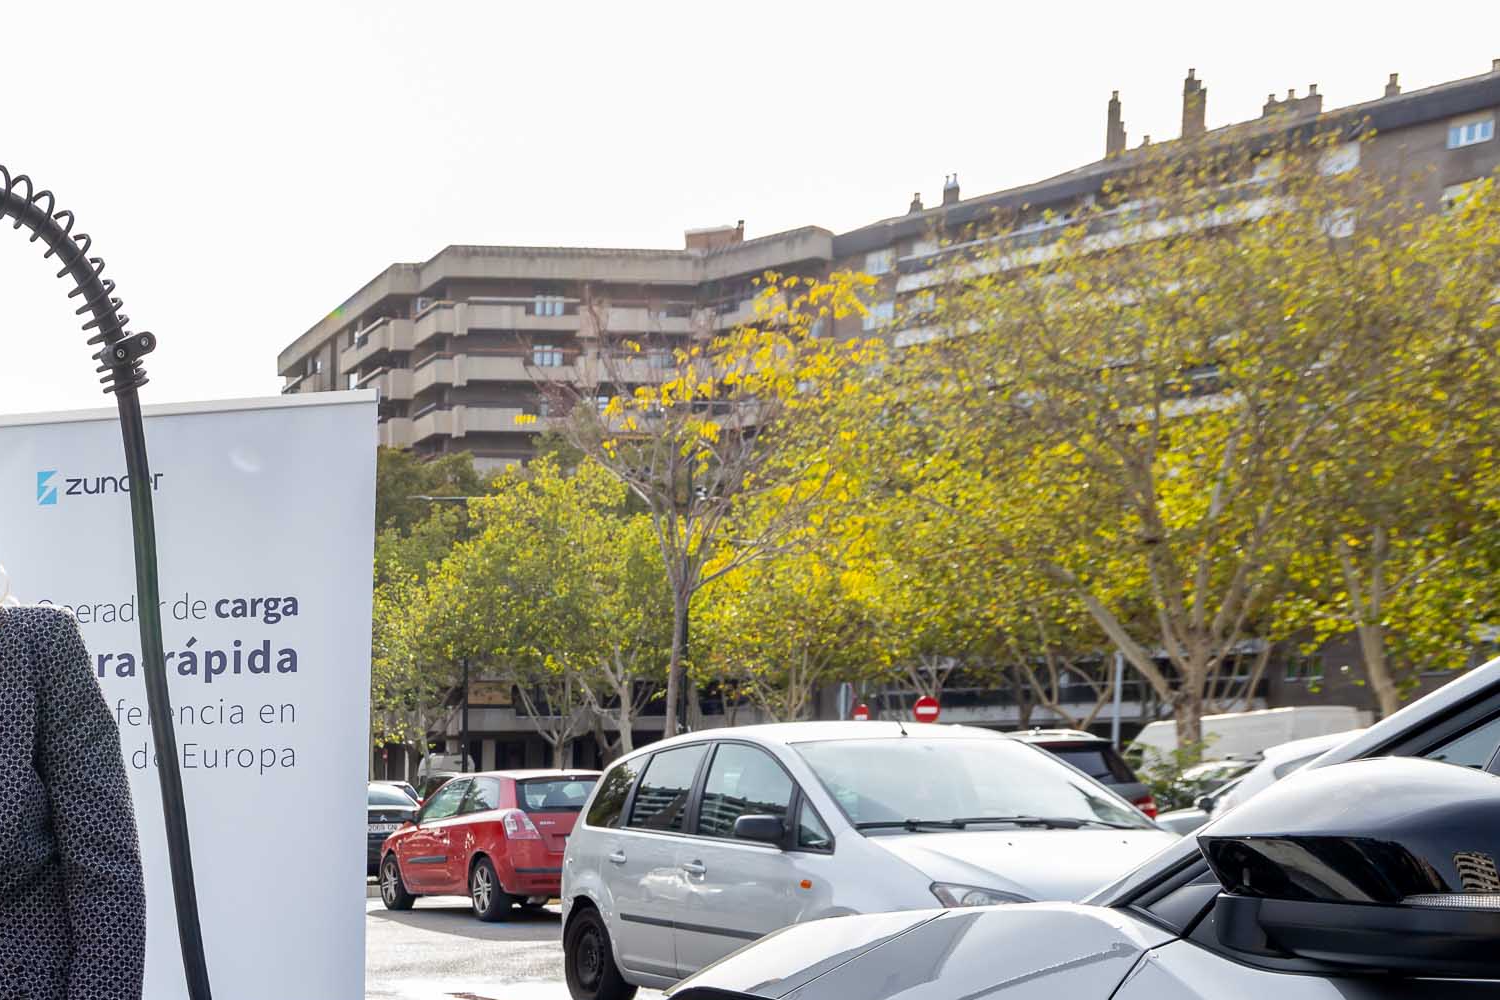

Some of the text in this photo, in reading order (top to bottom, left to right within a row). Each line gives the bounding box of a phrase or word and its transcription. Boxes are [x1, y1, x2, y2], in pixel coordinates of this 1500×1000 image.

[65, 473, 164, 495] zunr
[172, 592, 207, 621] de
[214, 596, 299, 624] carga
[116, 698, 295, 726] fencia en
[183, 743, 295, 776] Europa
